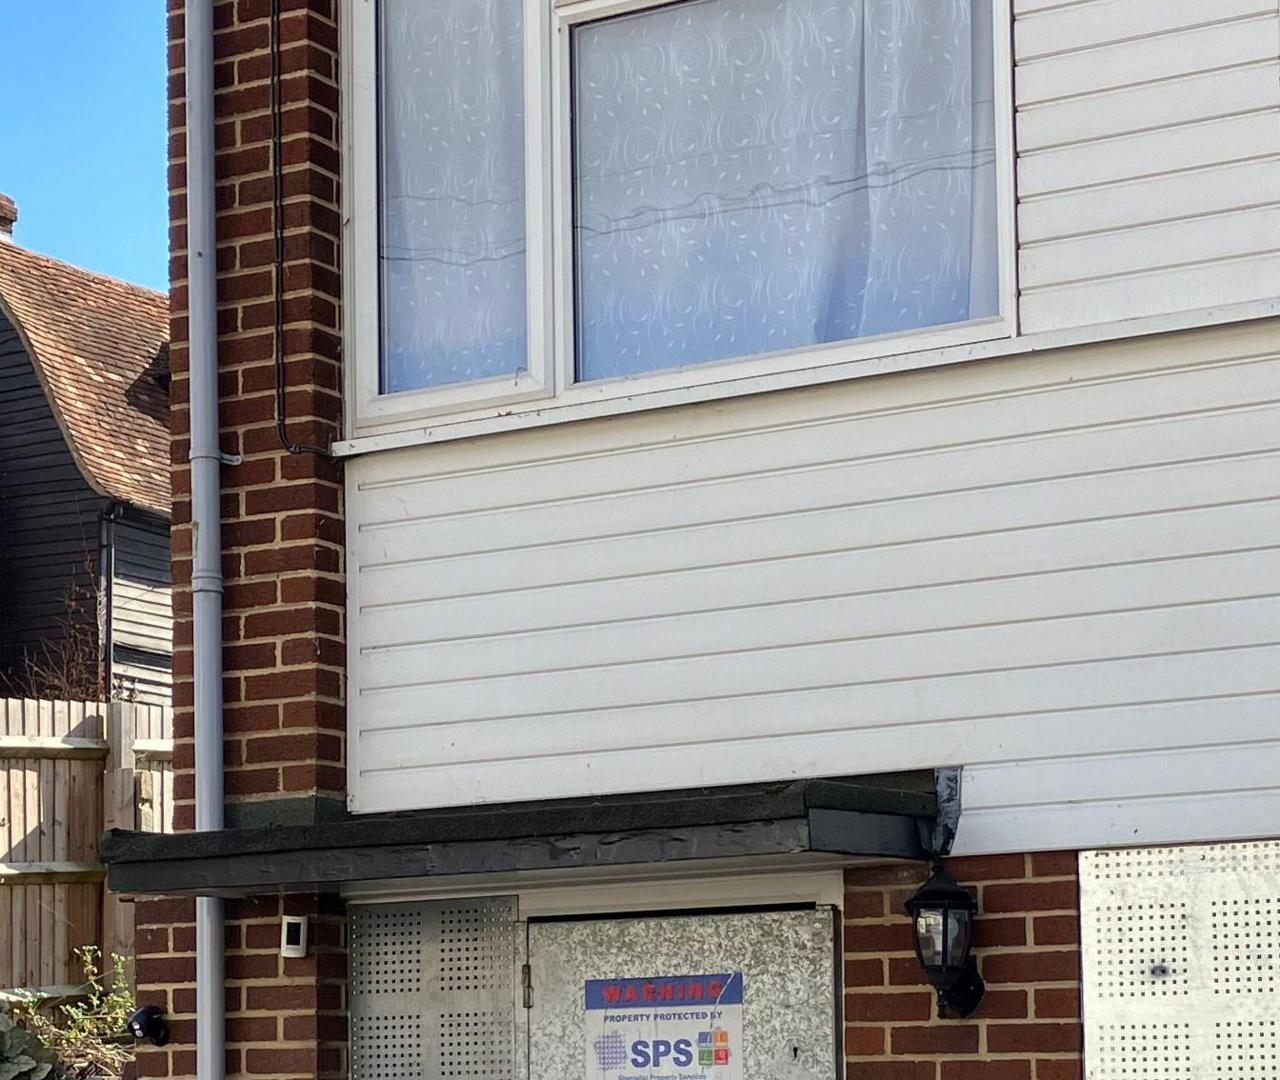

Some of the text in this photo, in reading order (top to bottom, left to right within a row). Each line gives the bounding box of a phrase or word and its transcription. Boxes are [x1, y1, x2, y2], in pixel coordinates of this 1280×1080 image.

[603, 981, 723, 1003] WARNING
[604, 1011, 723, 1023] PROPERTY PROTECTED BY
[631, 1038, 693, 1068] SPS
